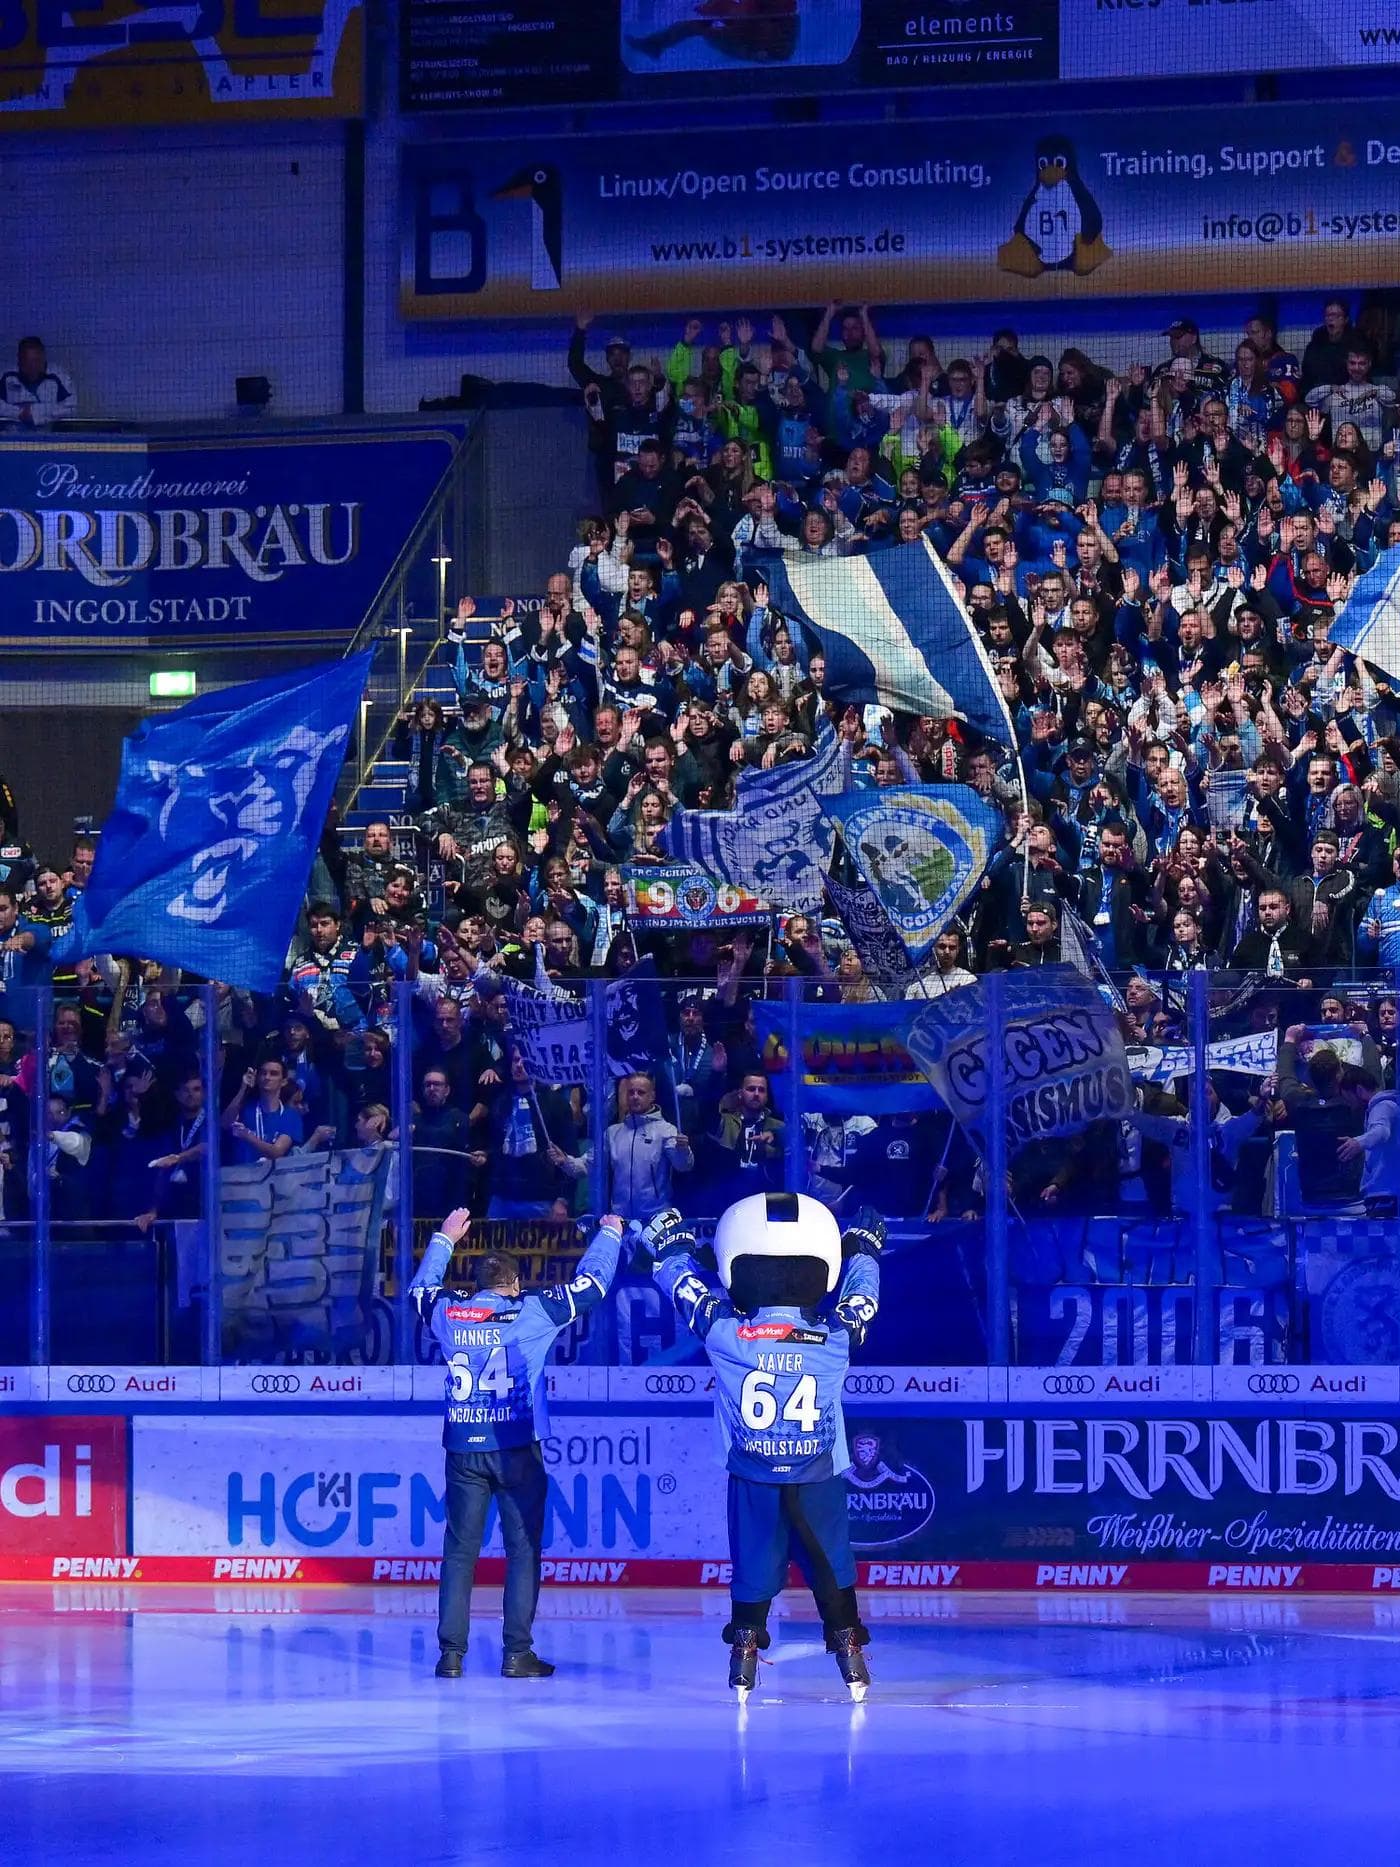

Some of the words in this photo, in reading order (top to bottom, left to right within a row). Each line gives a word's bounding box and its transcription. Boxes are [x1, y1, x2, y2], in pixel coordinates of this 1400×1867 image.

[904, 11, 1015, 37] elements
[986, 48, 1034, 62] ENERGIE
[1101, 149, 1213, 179] Training,
[1219, 146, 1326, 179] Support
[600, 168, 748, 200] Linux/Open
[755, 165, 840, 192] Source
[848, 159, 992, 191] Consulting,
[652, 229, 906, 263] www.b1-systems.de
[36, 462, 251, 500] Privatbrauerei
[0, 502, 360, 588] ORDBRÄU
[34, 595, 251, 625] INGOLSTADT
[946, 1008, 1106, 1106] GGEN
[453, 1328, 501, 1347] HANNES
[757, 1353, 803, 1373] XAVER
[124, 1375, 177, 1392] Audi
[309, 1375, 362, 1392] Audi
[904, 1376, 959, 1393] Audi
[1105, 1375, 1160, 1393] Audi
[1310, 1375, 1366, 1393] Audi
[739, 1369, 821, 1433] 64
[545, 1426, 651, 1466] sonal
[846, 1491, 927, 1511] RNBRÄU
[52, 1557, 140, 1579] PENNY
[213, 1558, 301, 1580] PENNY
[372, 1559, 441, 1581] PENN
[540, 1561, 627, 1583] PENNY
[867, 1564, 960, 1586] PENNY
[1035, 1565, 1129, 1587] PENNY
[1207, 1566, 1302, 1588] PENNY
